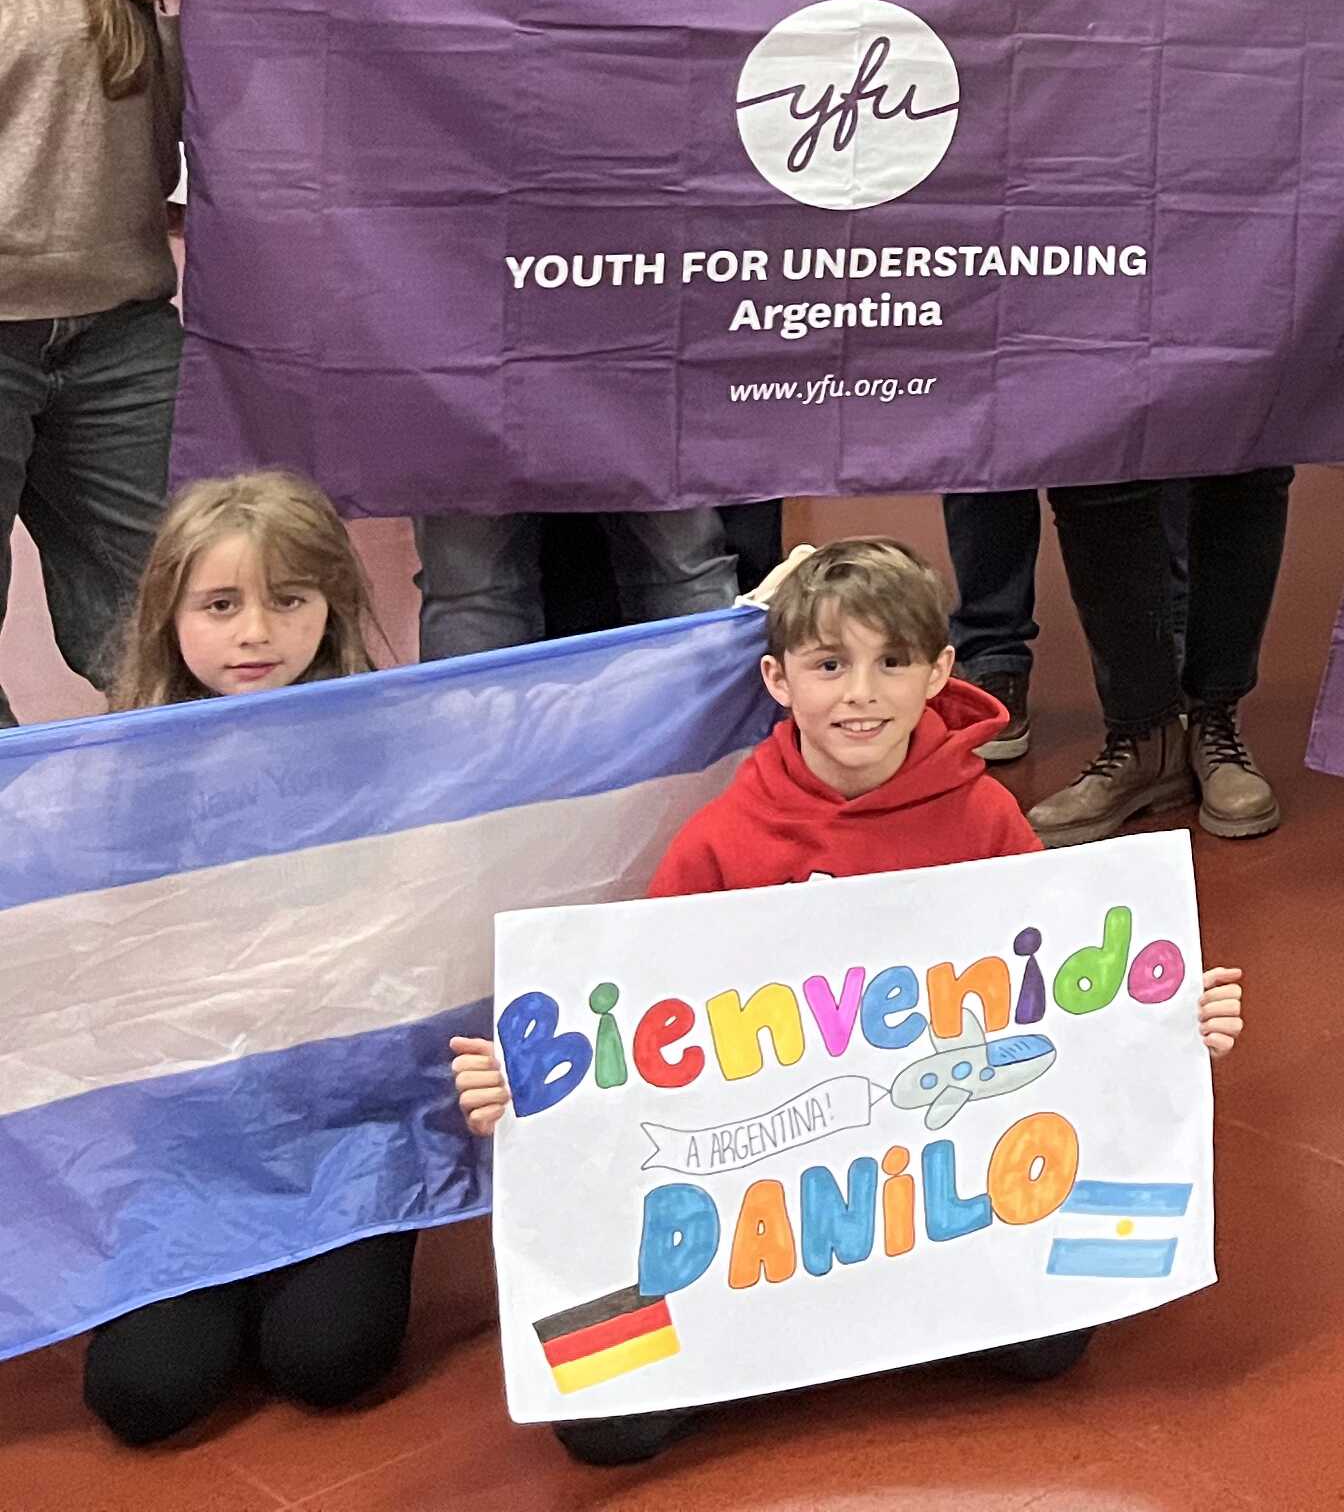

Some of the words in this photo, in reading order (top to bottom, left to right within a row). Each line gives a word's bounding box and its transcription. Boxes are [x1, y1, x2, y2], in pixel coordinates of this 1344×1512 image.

[738, 36, 958, 173] yfu
[505, 252, 666, 289] YOUTH
[681, 249, 769, 283] FOR
[782, 244, 1148, 281] UNDERSTANDING
[729, 293, 943, 339] Argentina
[729, 374, 936, 406] www.yfu.org.ar
[498, 906, 1186, 1117] Bienvenido
[686, 1135, 701, 1168] A
[710, 1093, 835, 1168] ARGENTINA!
